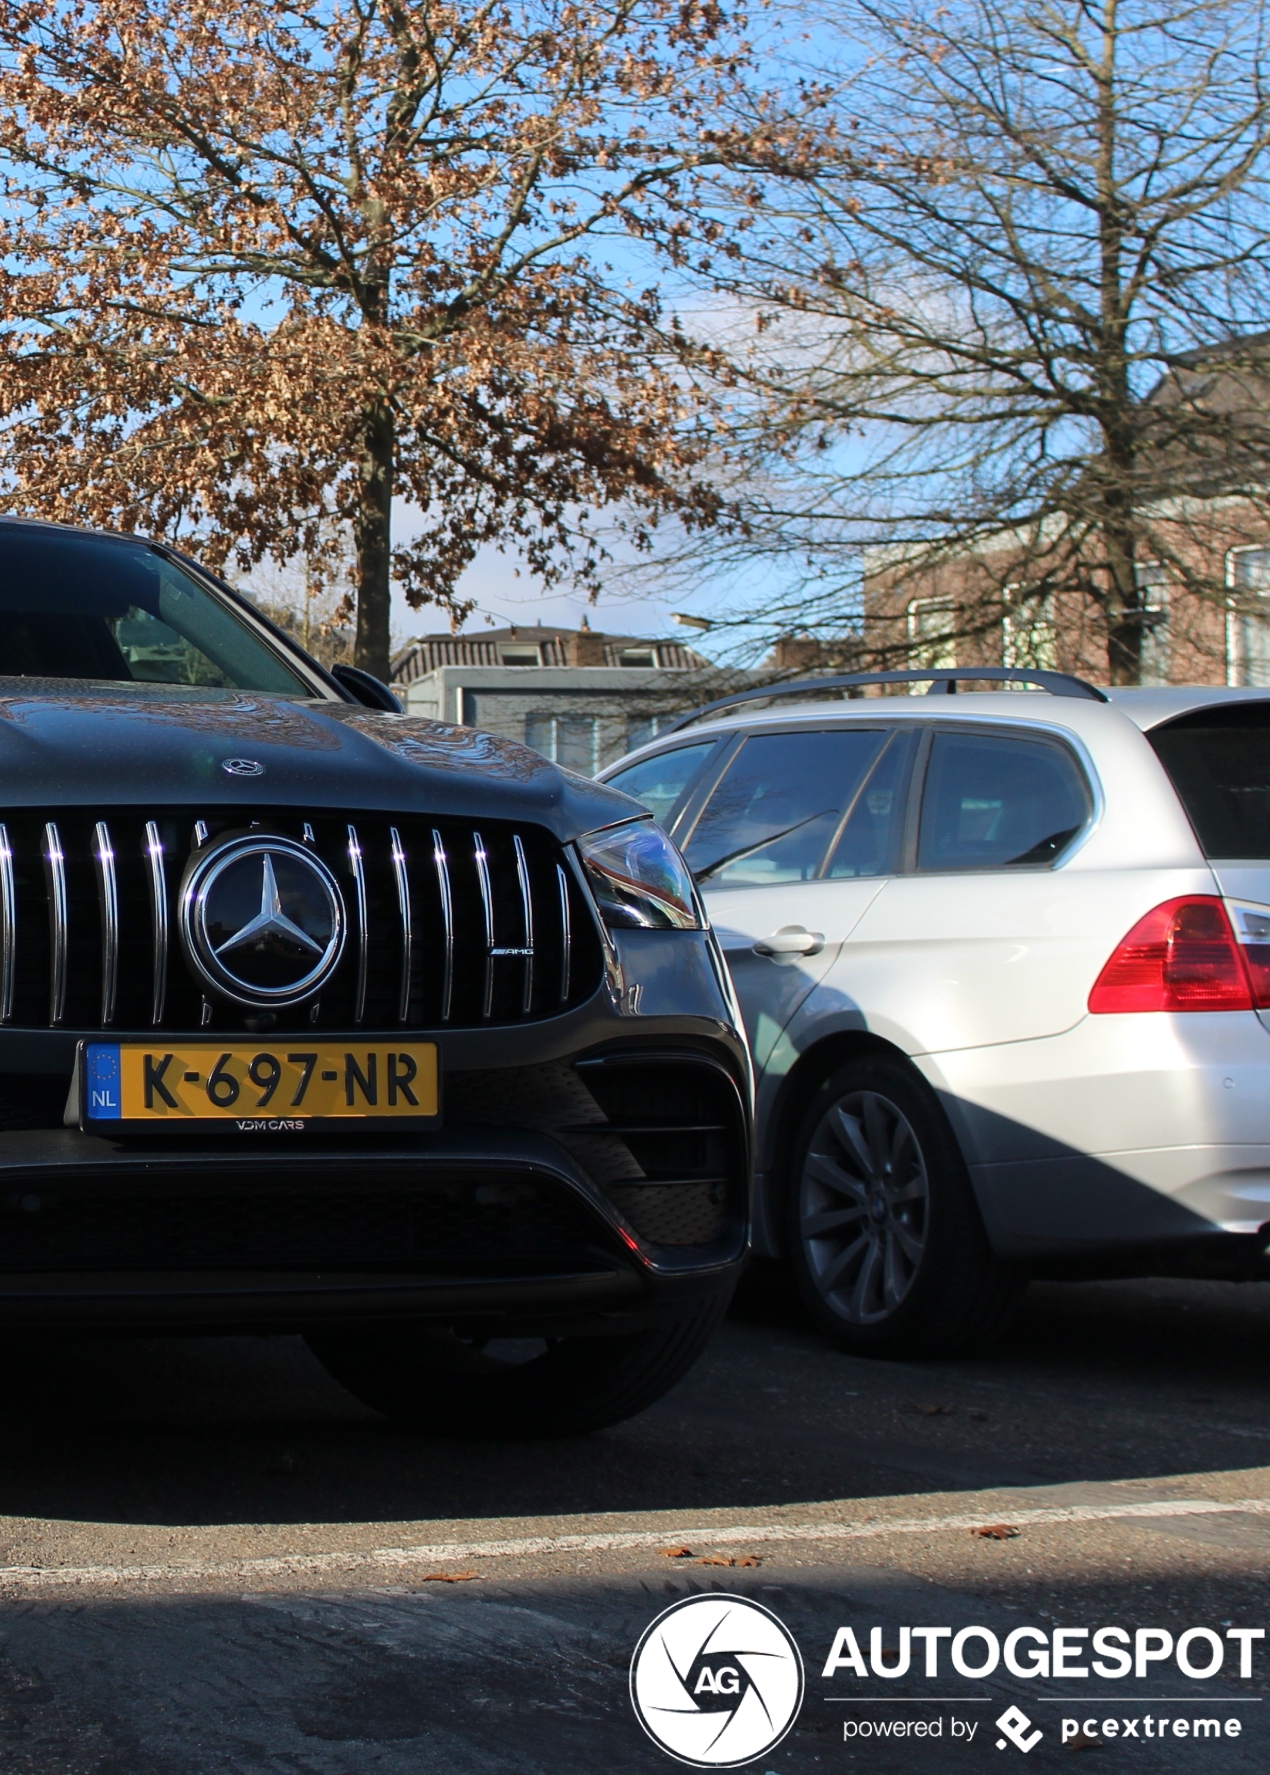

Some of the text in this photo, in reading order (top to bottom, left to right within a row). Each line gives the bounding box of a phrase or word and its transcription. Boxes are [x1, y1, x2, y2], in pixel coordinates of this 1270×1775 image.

[143, 1053, 420, 1109] K-697-NR
[92, 1090, 117, 1107] NL
[236, 1120, 305, 1131] VDM CARS
